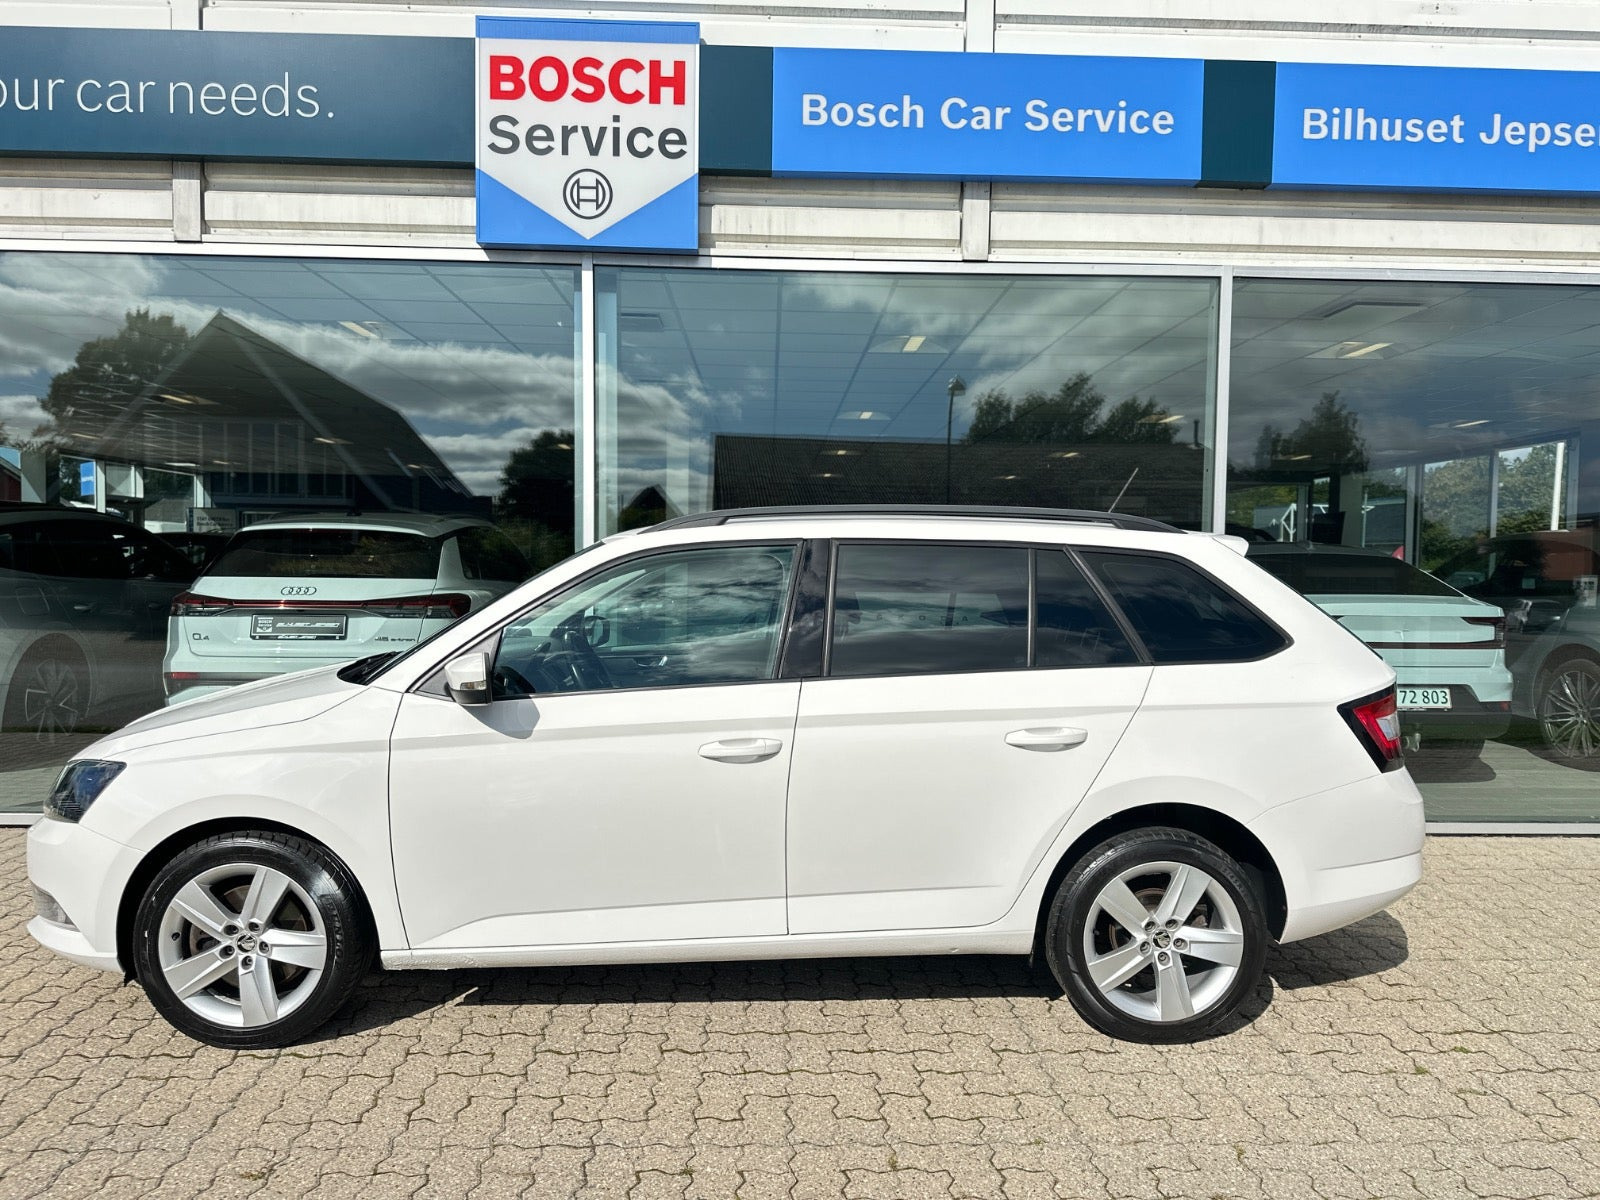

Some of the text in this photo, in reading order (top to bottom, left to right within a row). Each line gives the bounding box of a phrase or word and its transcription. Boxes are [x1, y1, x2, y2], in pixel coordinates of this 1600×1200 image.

[76, 78, 156, 113] car
[168, 71, 335, 118] needs.
[489, 55, 686, 106] BOSCH
[487, 114, 688, 160] Service
[802, 93, 1175, 135] Bosch Car Service
[1302, 107, 1600, 153] Bilhuset Jepse
[1399, 690, 1449, 705] 72 803
